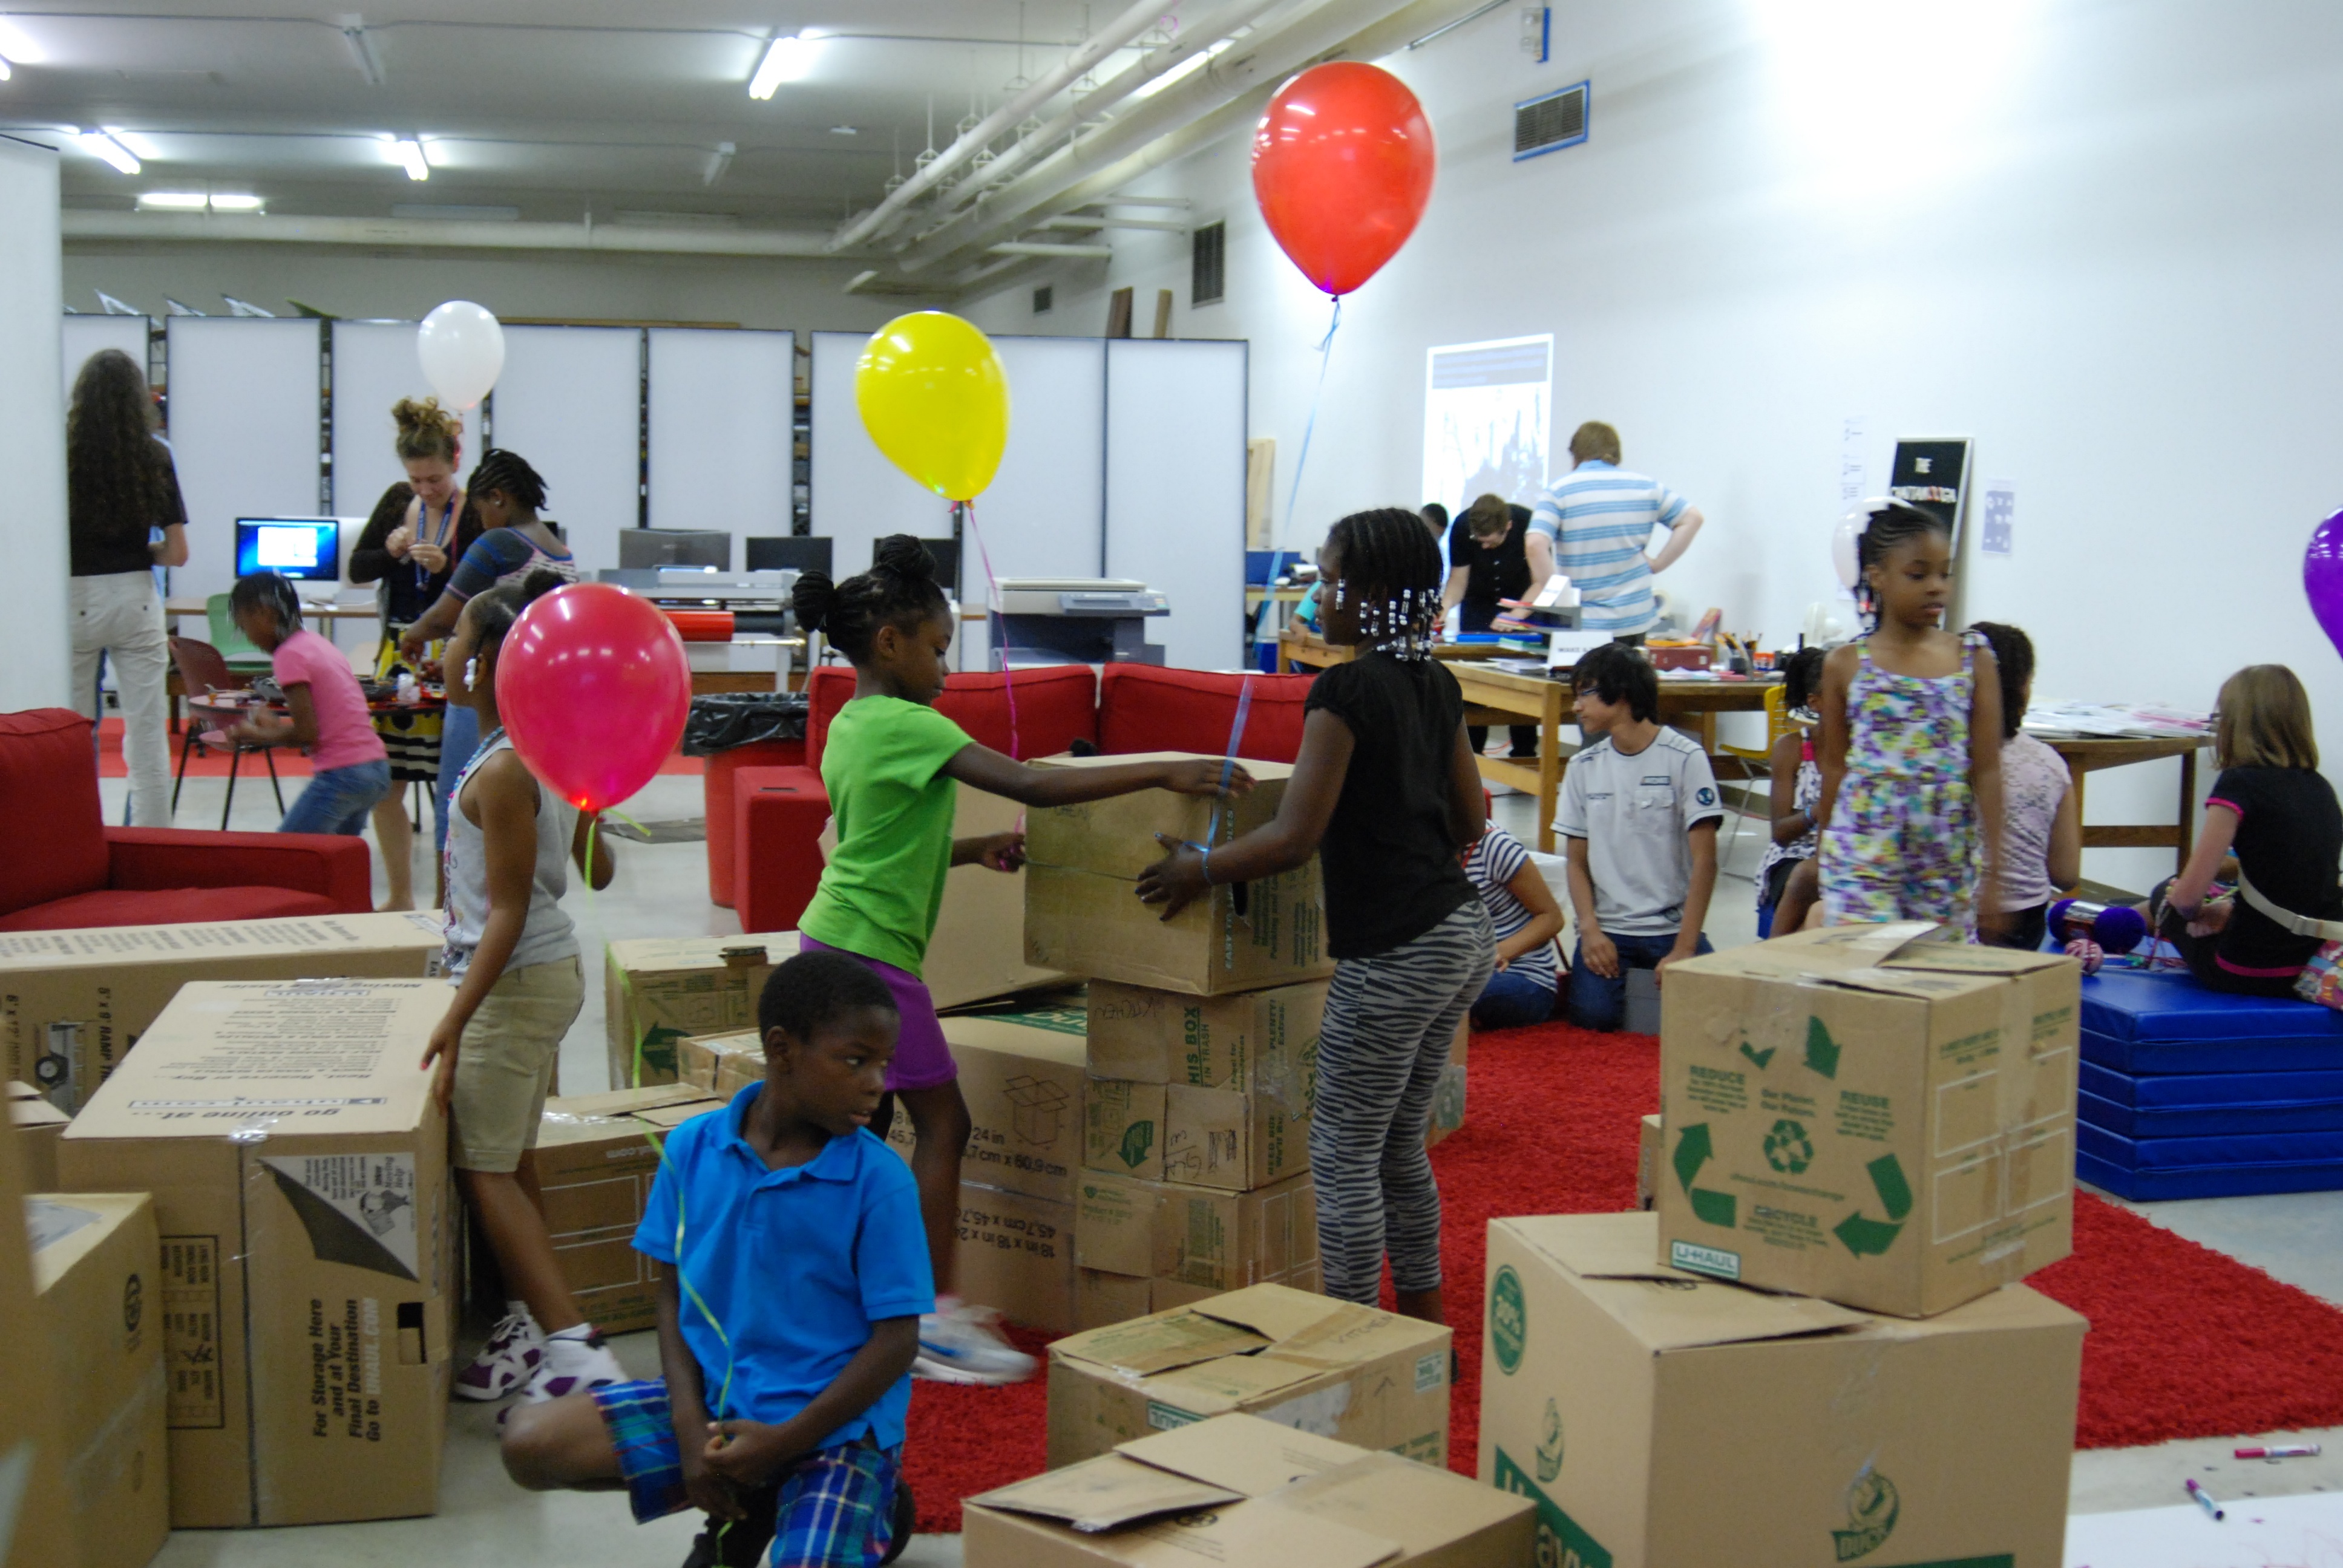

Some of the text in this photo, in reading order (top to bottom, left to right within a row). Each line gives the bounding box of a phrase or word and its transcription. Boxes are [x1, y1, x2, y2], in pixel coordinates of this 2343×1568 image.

[1184, 1007, 1200, 1084] HIS BOX
[1201, 1024, 1211, 1078] IN TRASH
[1689, 1065, 1745, 1085] REDUCE
[1840, 1090, 1889, 1108] REUSE
[201, 1110, 295, 1119] online
[303, 1108, 341, 1117] go
[1003, 1156, 1012, 1166] x
[385, 1157, 394, 1188] Moving
[992, 1216, 1000, 1224] x
[971, 1230, 978, 1239] x
[1015, 1238, 1022, 1247] x
[1676, 1246, 1735, 1268] U-HAUL
[308, 1298, 327, 1437] For Storage Here
[327, 1323, 344, 1417] and at Your
[345, 1299, 362, 1438] Final Destination
[365, 1399, 379, 1416] to
[365, 1421, 380, 1442] Go
